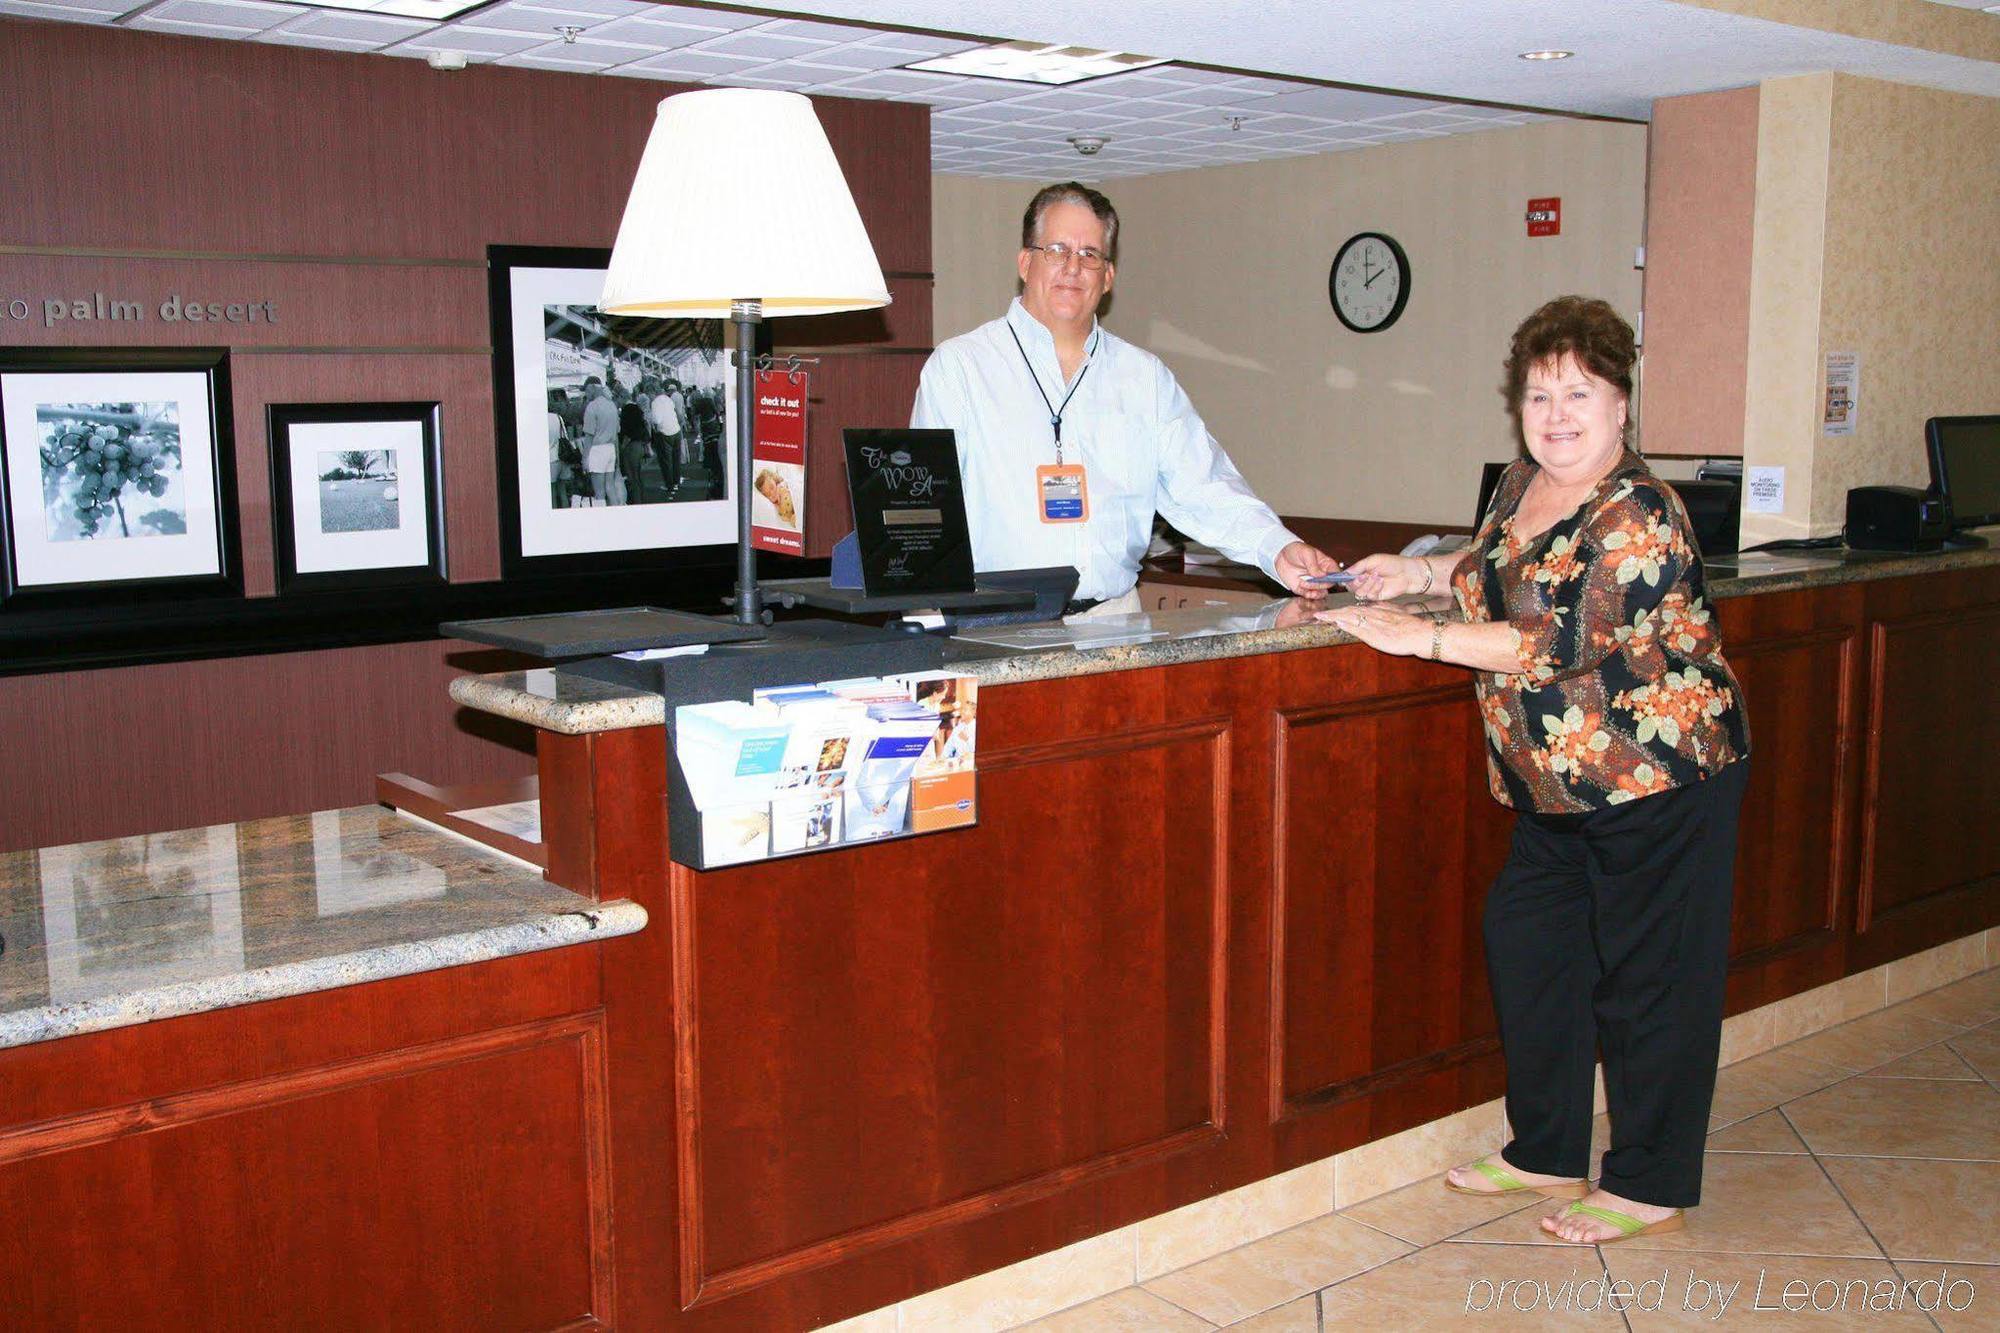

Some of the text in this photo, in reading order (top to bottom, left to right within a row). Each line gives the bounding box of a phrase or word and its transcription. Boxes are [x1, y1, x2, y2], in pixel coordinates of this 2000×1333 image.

[0, 292, 279, 327] o palm desert
[760, 396, 800, 408] check it out
[762, 536, 780, 544] sweet
